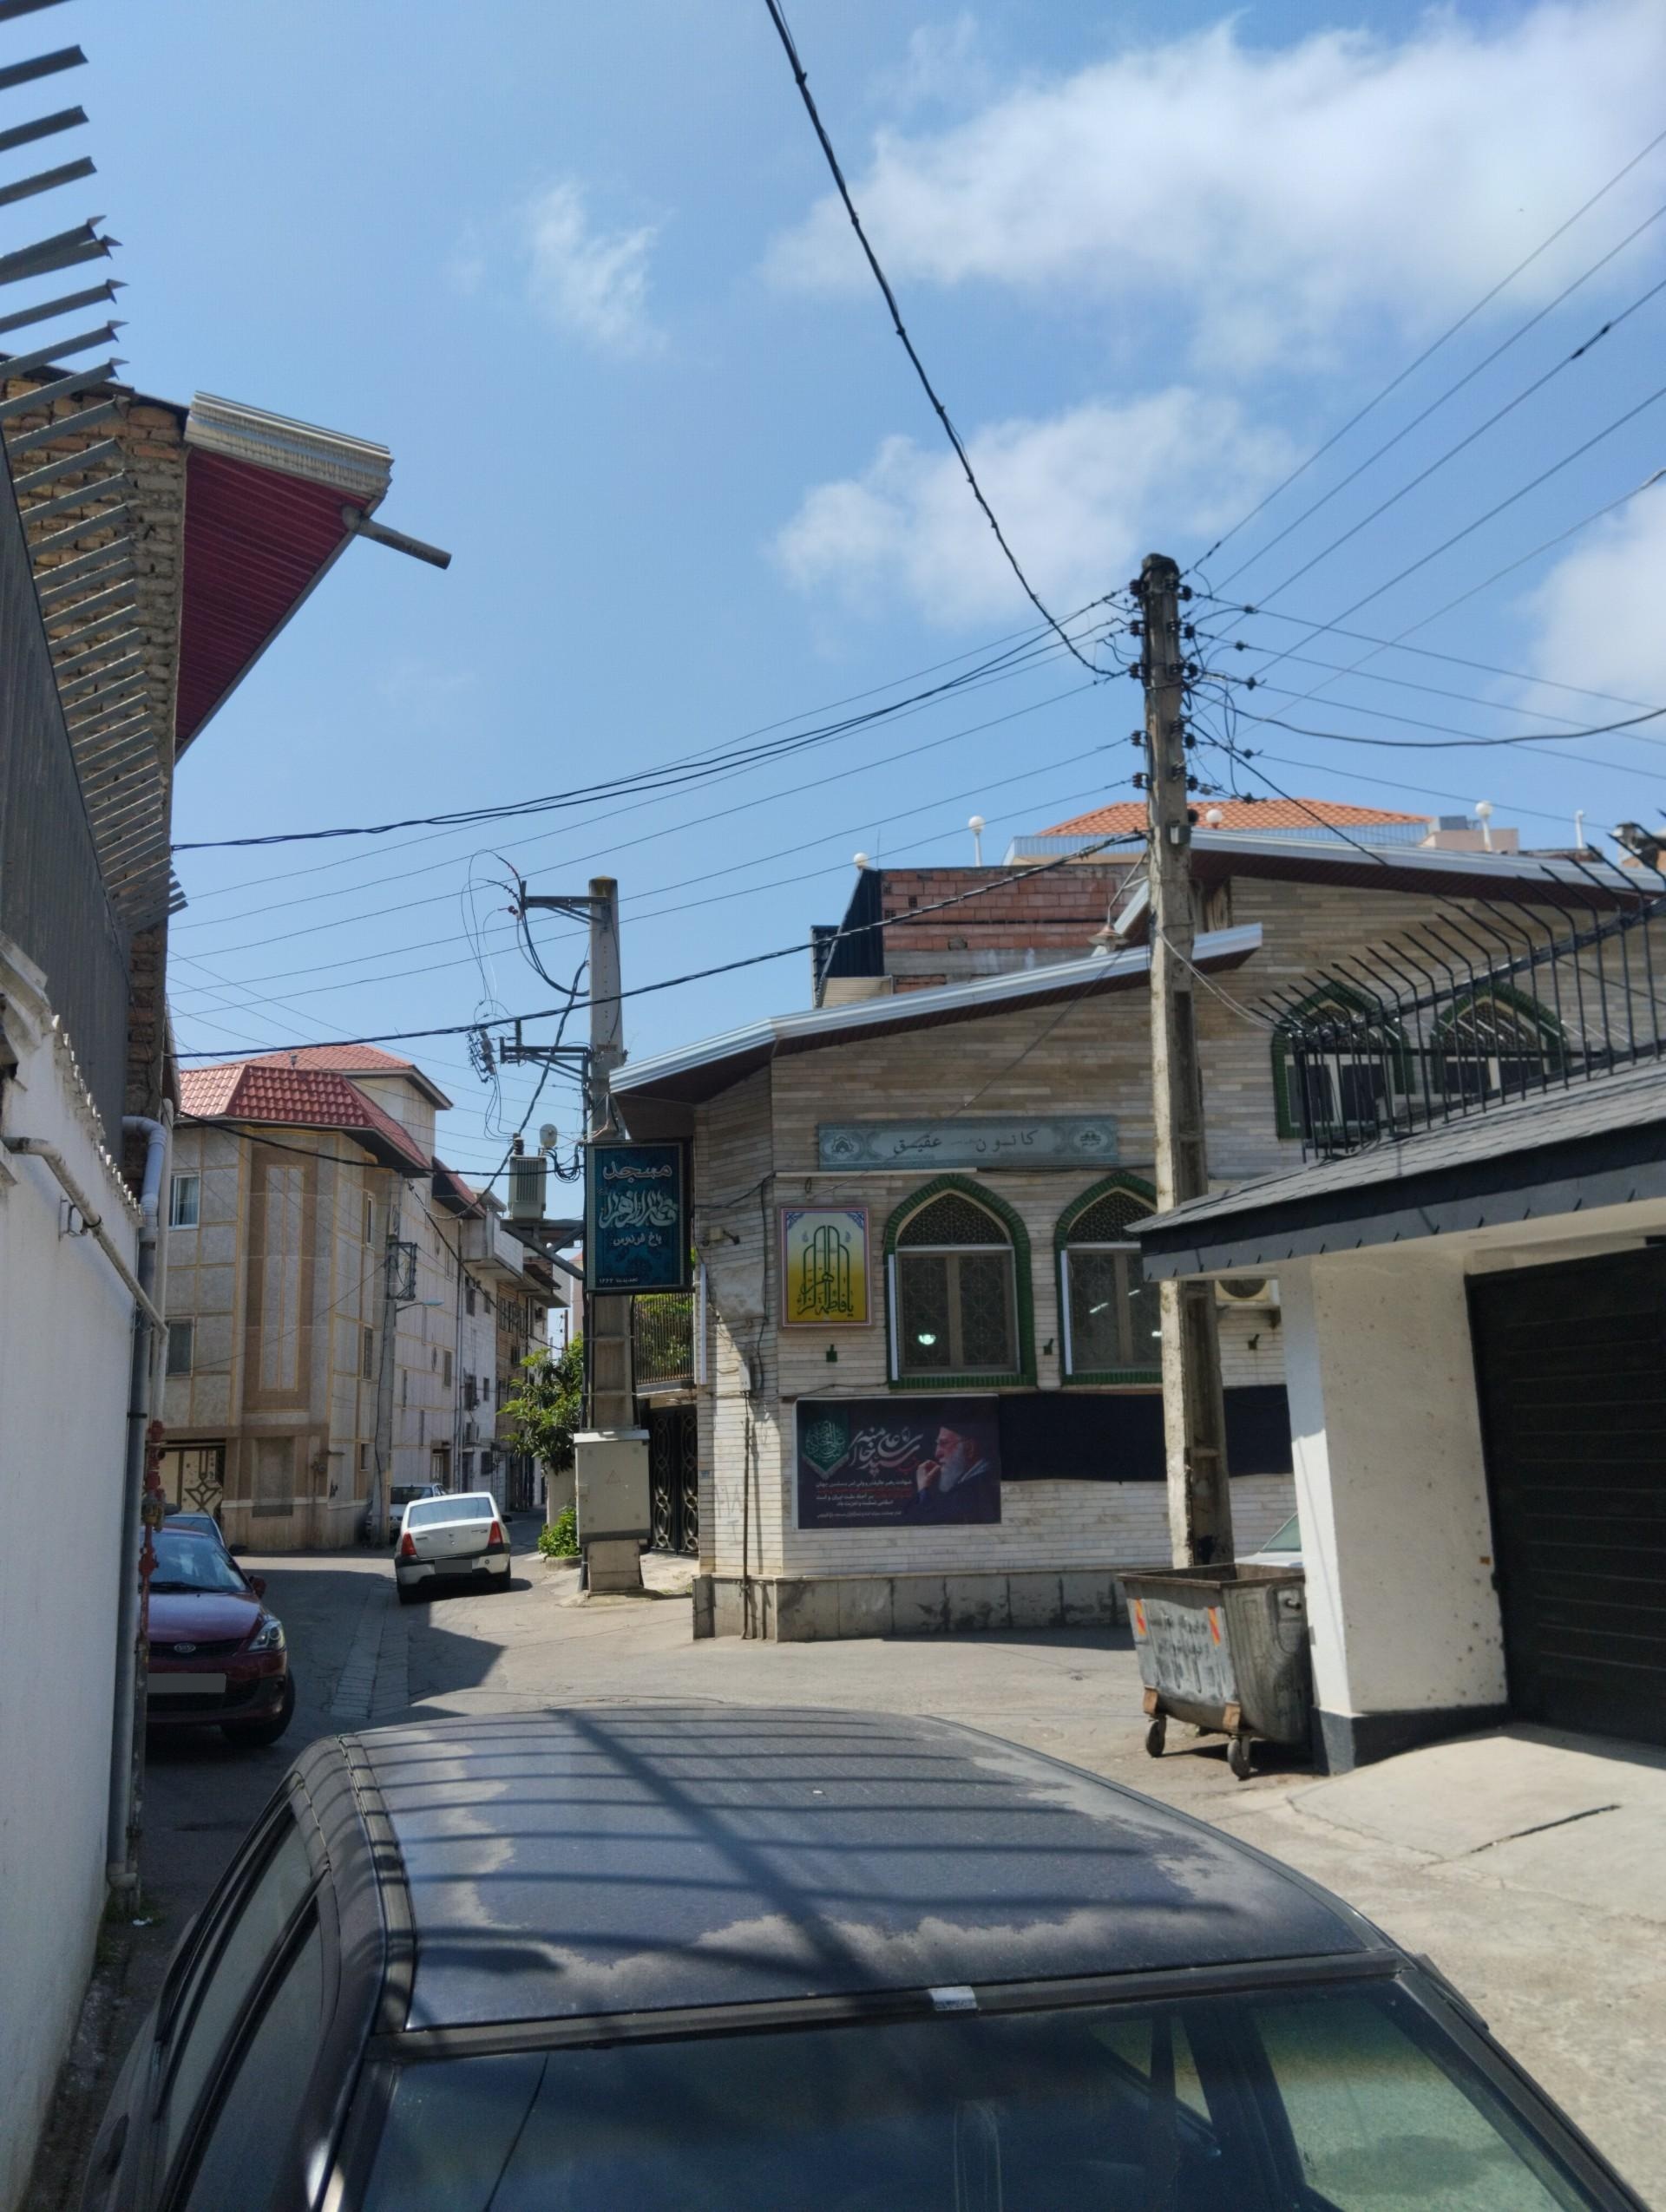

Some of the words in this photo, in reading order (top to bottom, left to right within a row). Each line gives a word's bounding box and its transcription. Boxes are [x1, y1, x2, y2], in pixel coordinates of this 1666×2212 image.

[893, 1134, 943, 1155] عقیق
[975, 1129, 1040, 1153] کانون
[602, 1161, 673, 1184] مسجد
[613, 1232, 646, 1247] فردوس
[647, 1231, 663, 1247] باغ
